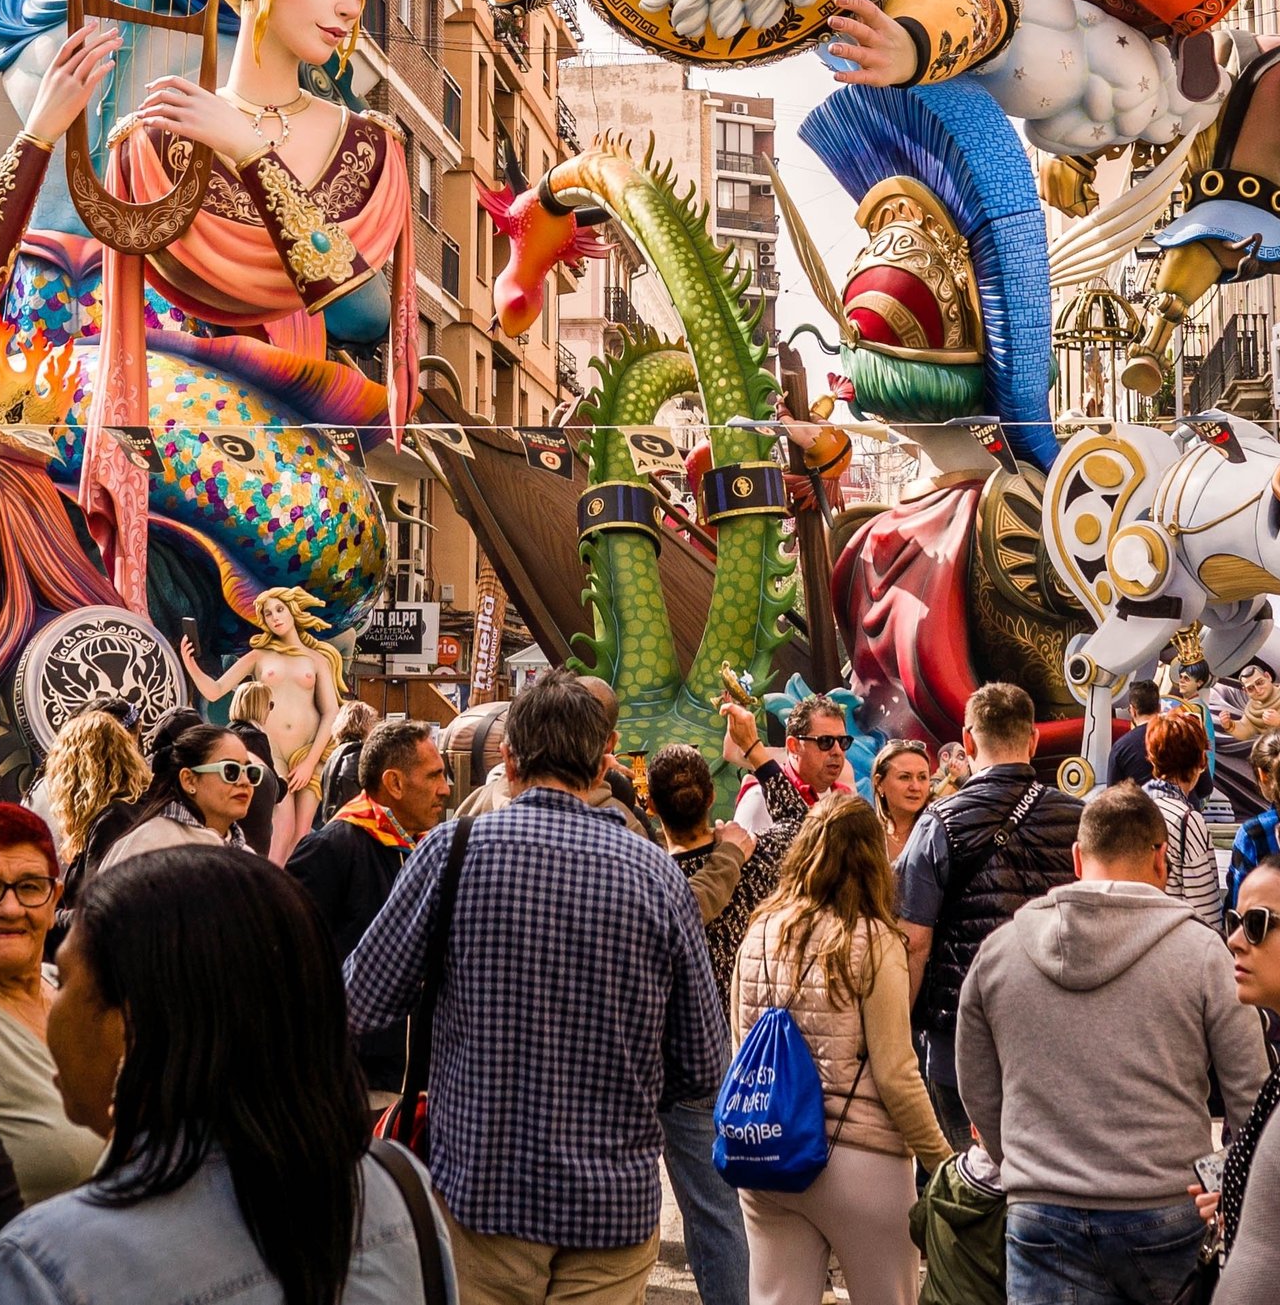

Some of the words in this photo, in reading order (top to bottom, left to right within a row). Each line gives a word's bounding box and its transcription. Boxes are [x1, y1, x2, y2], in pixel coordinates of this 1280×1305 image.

[652, 459, 684, 470] Punt
[389, 611, 417, 627] ALPA
[474, 595, 495, 690] huella
[486, 626, 500, 674] Vegamar
